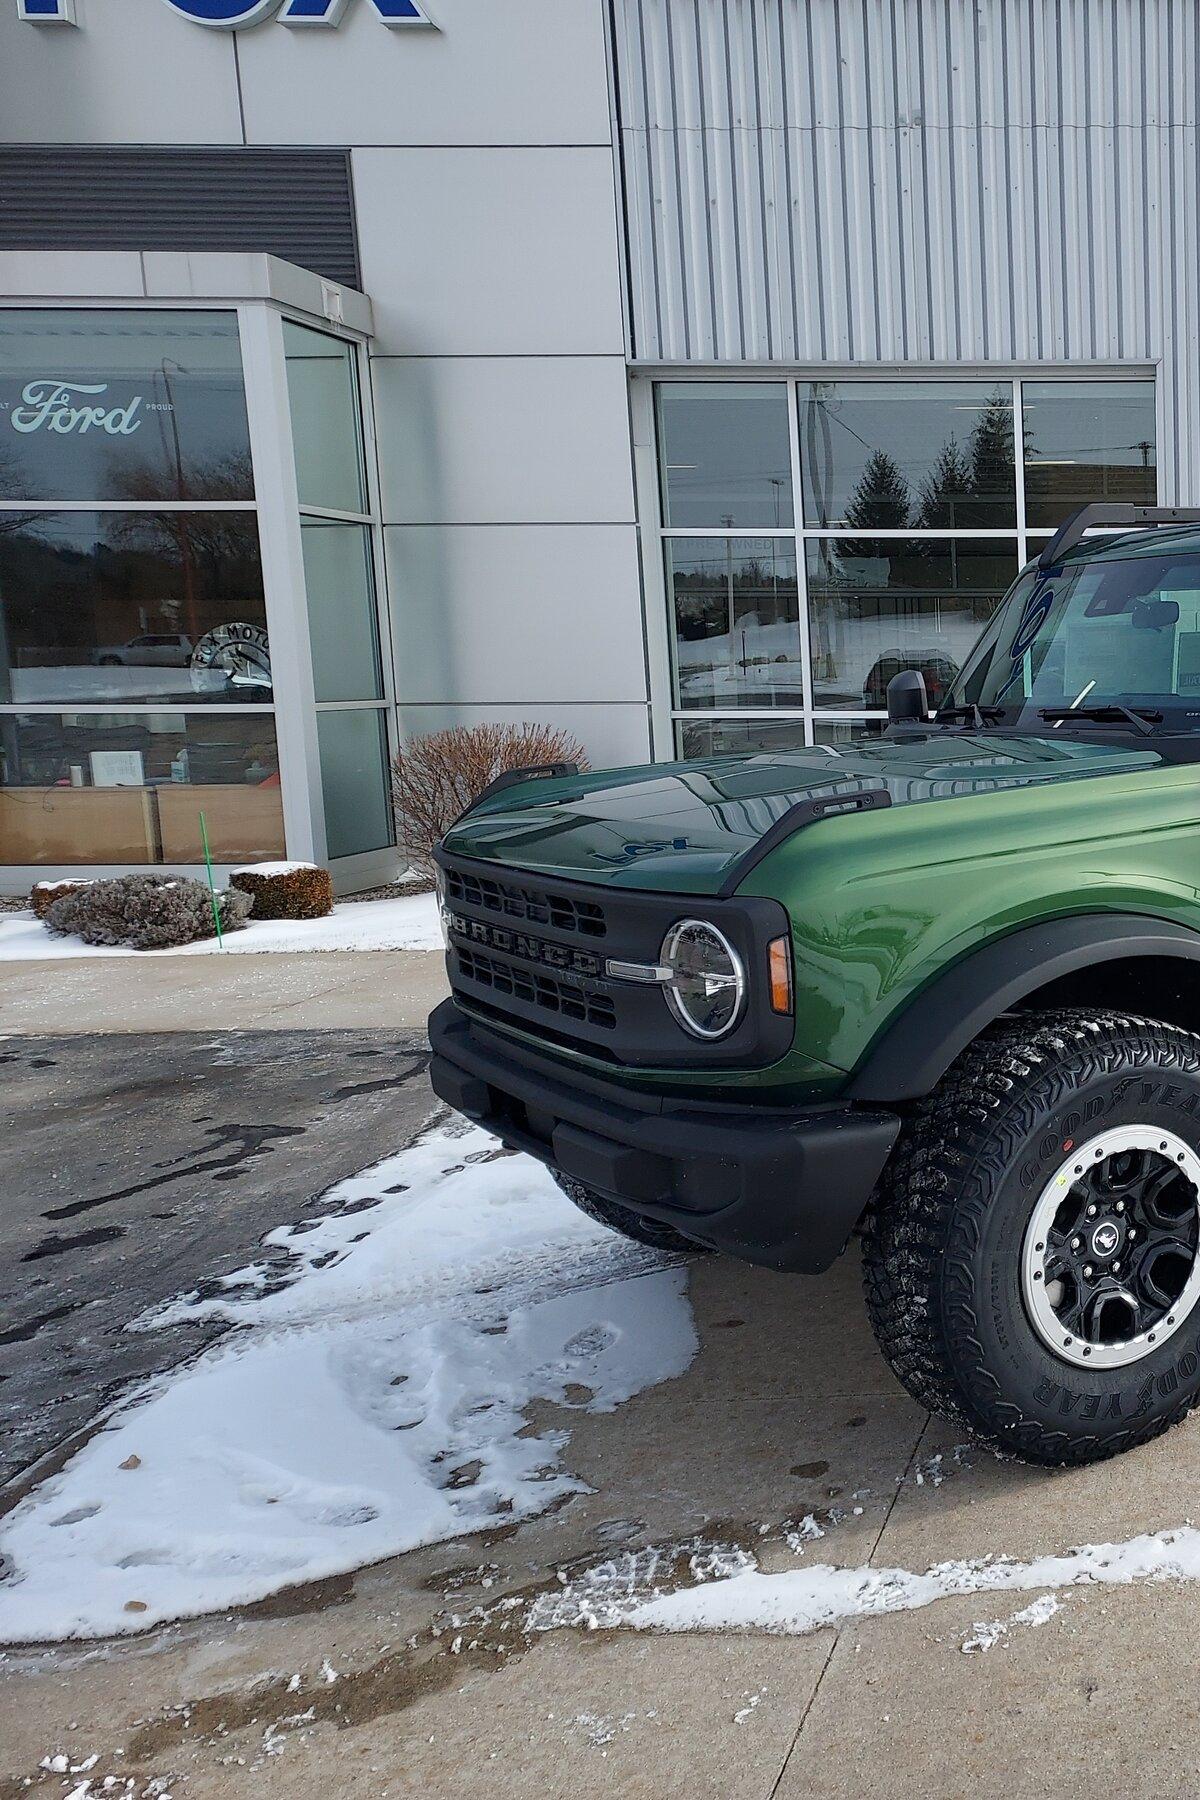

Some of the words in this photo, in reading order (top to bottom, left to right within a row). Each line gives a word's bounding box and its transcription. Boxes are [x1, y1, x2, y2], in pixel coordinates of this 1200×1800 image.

[11, 379, 142, 434] Ford
[146, 403, 174, 411] PROUD
[452, 912, 599, 974] BRONCO
